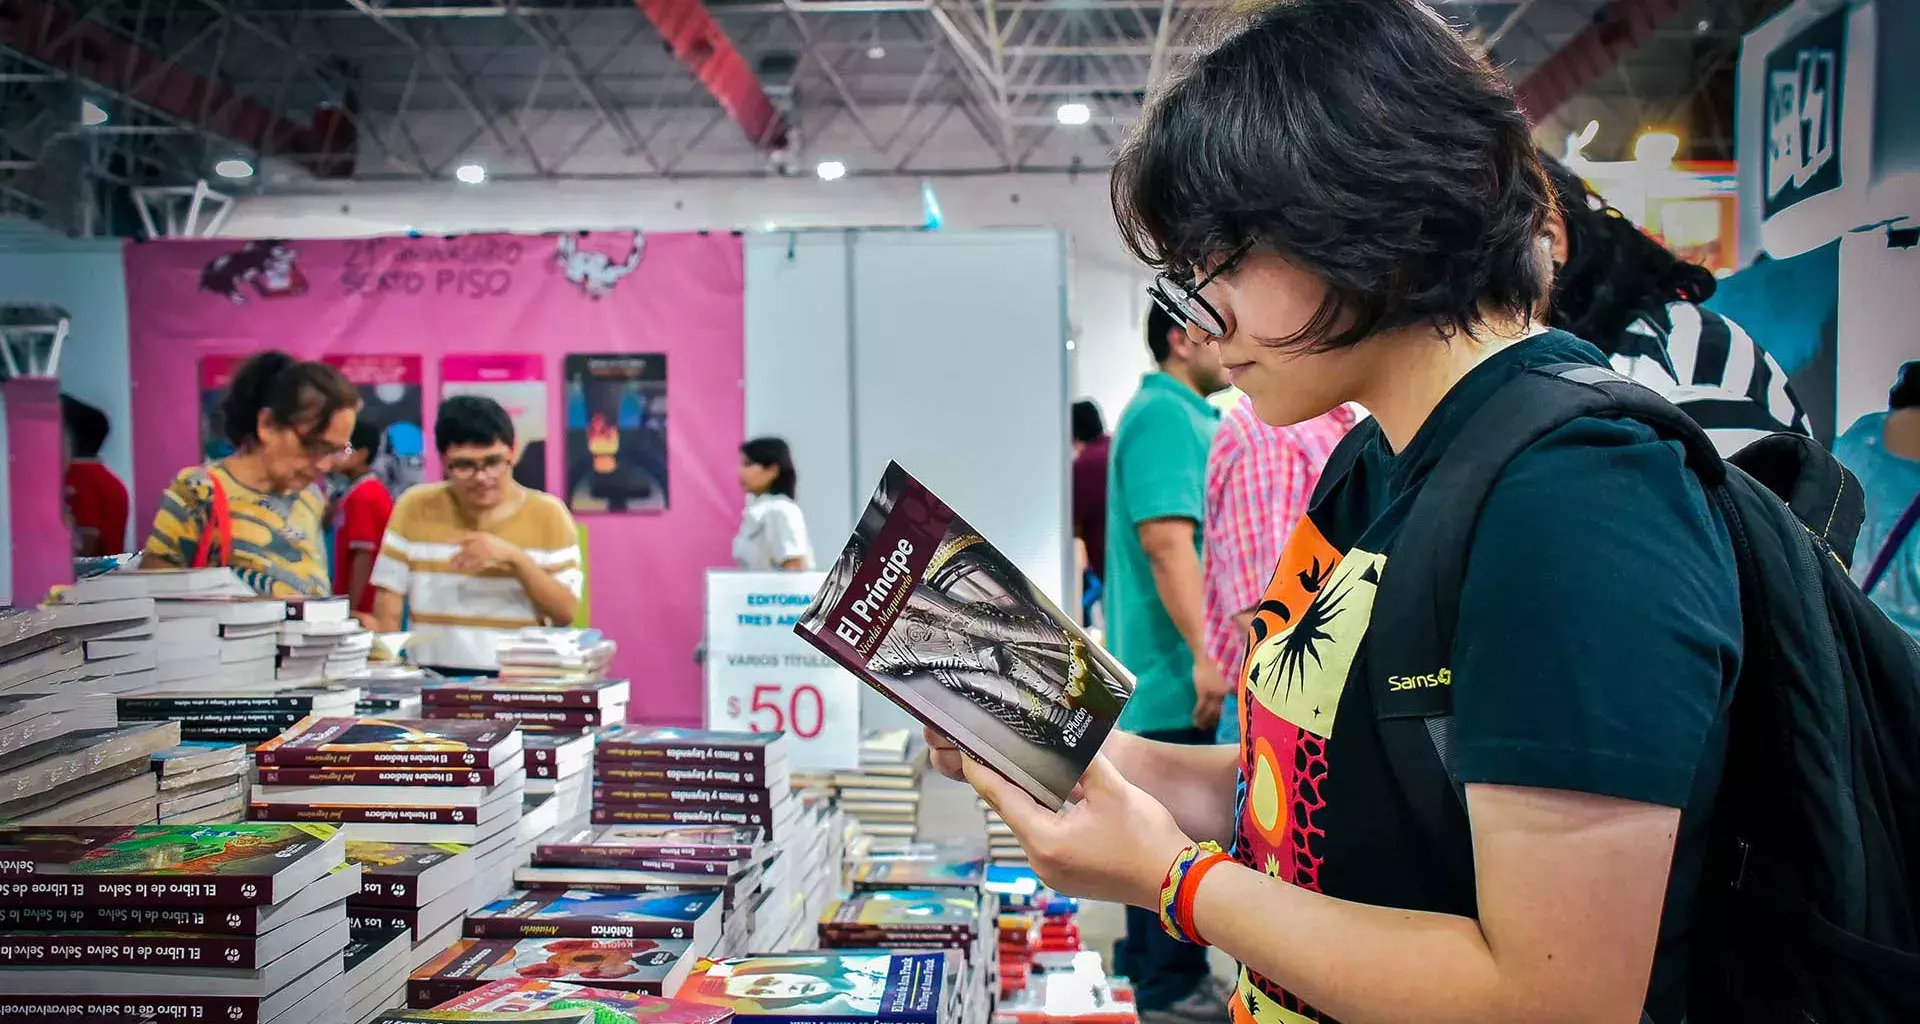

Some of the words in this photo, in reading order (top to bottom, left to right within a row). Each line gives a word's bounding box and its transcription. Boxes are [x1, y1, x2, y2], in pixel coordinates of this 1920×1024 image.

[436, 268, 512, 299] PISO
[835, 616, 864, 646] El
[851, 539, 913, 622] Príncipe
[747, 595, 812, 605] EDITORIA
[857, 625, 882, 659] Nicolás
[877, 574, 912, 626] Maquiavelo
[1067, 707, 1087, 733] Plutón
[399, 811, 429, 820] Hombre
[430, 811, 438, 820] El
[12, 884, 28, 897] de
[71, 884, 85, 896] EL
[99, 884, 132, 897] Selva
[135, 884, 147, 897] la
[150, 884, 166, 897] de
[170, 884, 200, 897] Libro
[203, 884, 217, 896] EL
[364, 883, 382, 895] Los
[23, 908, 53, 922] Selva
[56, 910, 67, 923] la
[70, 911, 84, 923] de
[98, 909, 128, 921] Selva
[131, 910, 142, 923] la
[145, 910, 159, 923] de
[162, 911, 189, 924] Libro
[191, 912, 205, 924] EL
[364, 917, 382, 929] Los
[591, 925, 634, 938] Retórica
[51, 945, 82, 959] Selva
[87, 945, 119, 959] Selva
[122, 946, 134, 960] la
[137, 946, 153, 960] de
[155, 947, 185, 960] Libro
[188, 947, 201, 960] EL
[88, 1004, 120, 1016] Selva
[139, 1005, 154, 1018] de
[157, 1005, 187, 1018] Libro
[190, 1005, 204, 1018] EL
